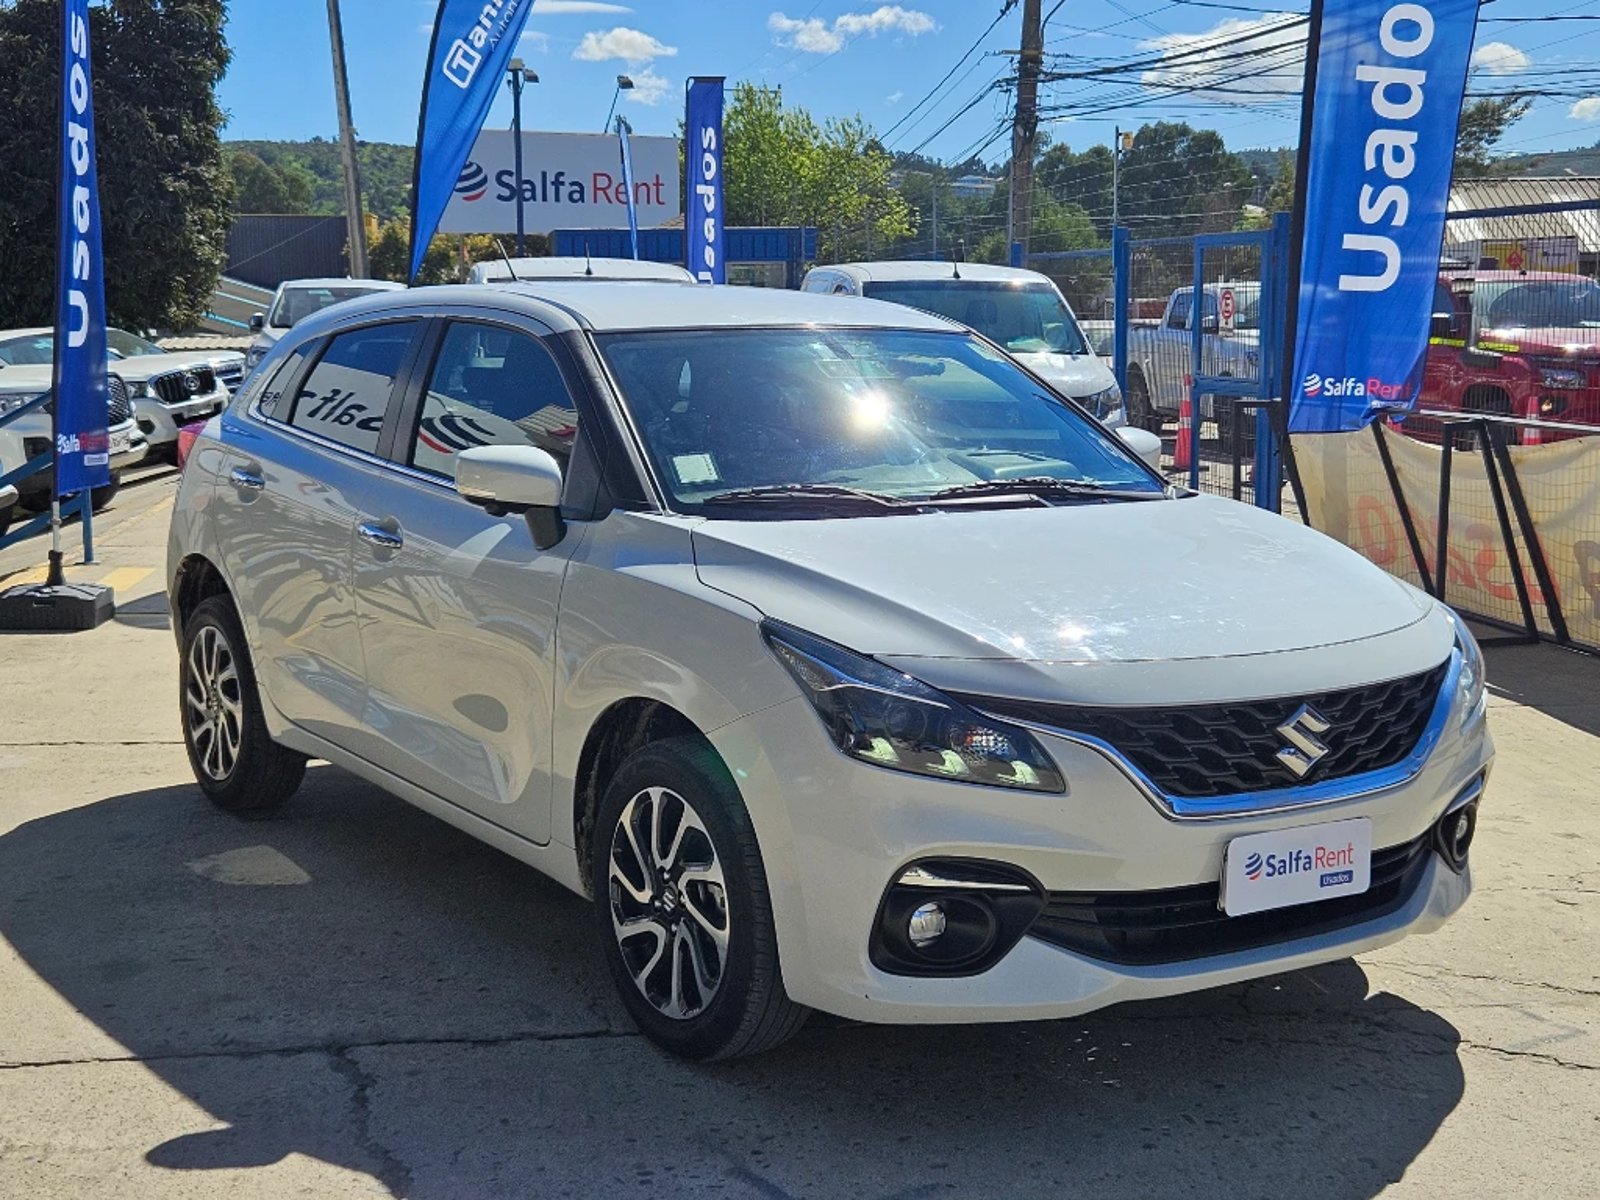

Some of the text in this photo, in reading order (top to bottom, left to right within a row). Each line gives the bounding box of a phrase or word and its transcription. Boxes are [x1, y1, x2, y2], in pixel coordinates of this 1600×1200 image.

[67, 10, 90, 348] Usados
[1338, 3, 1435, 292] Usado
[1322, 873, 1350, 886] Usados
